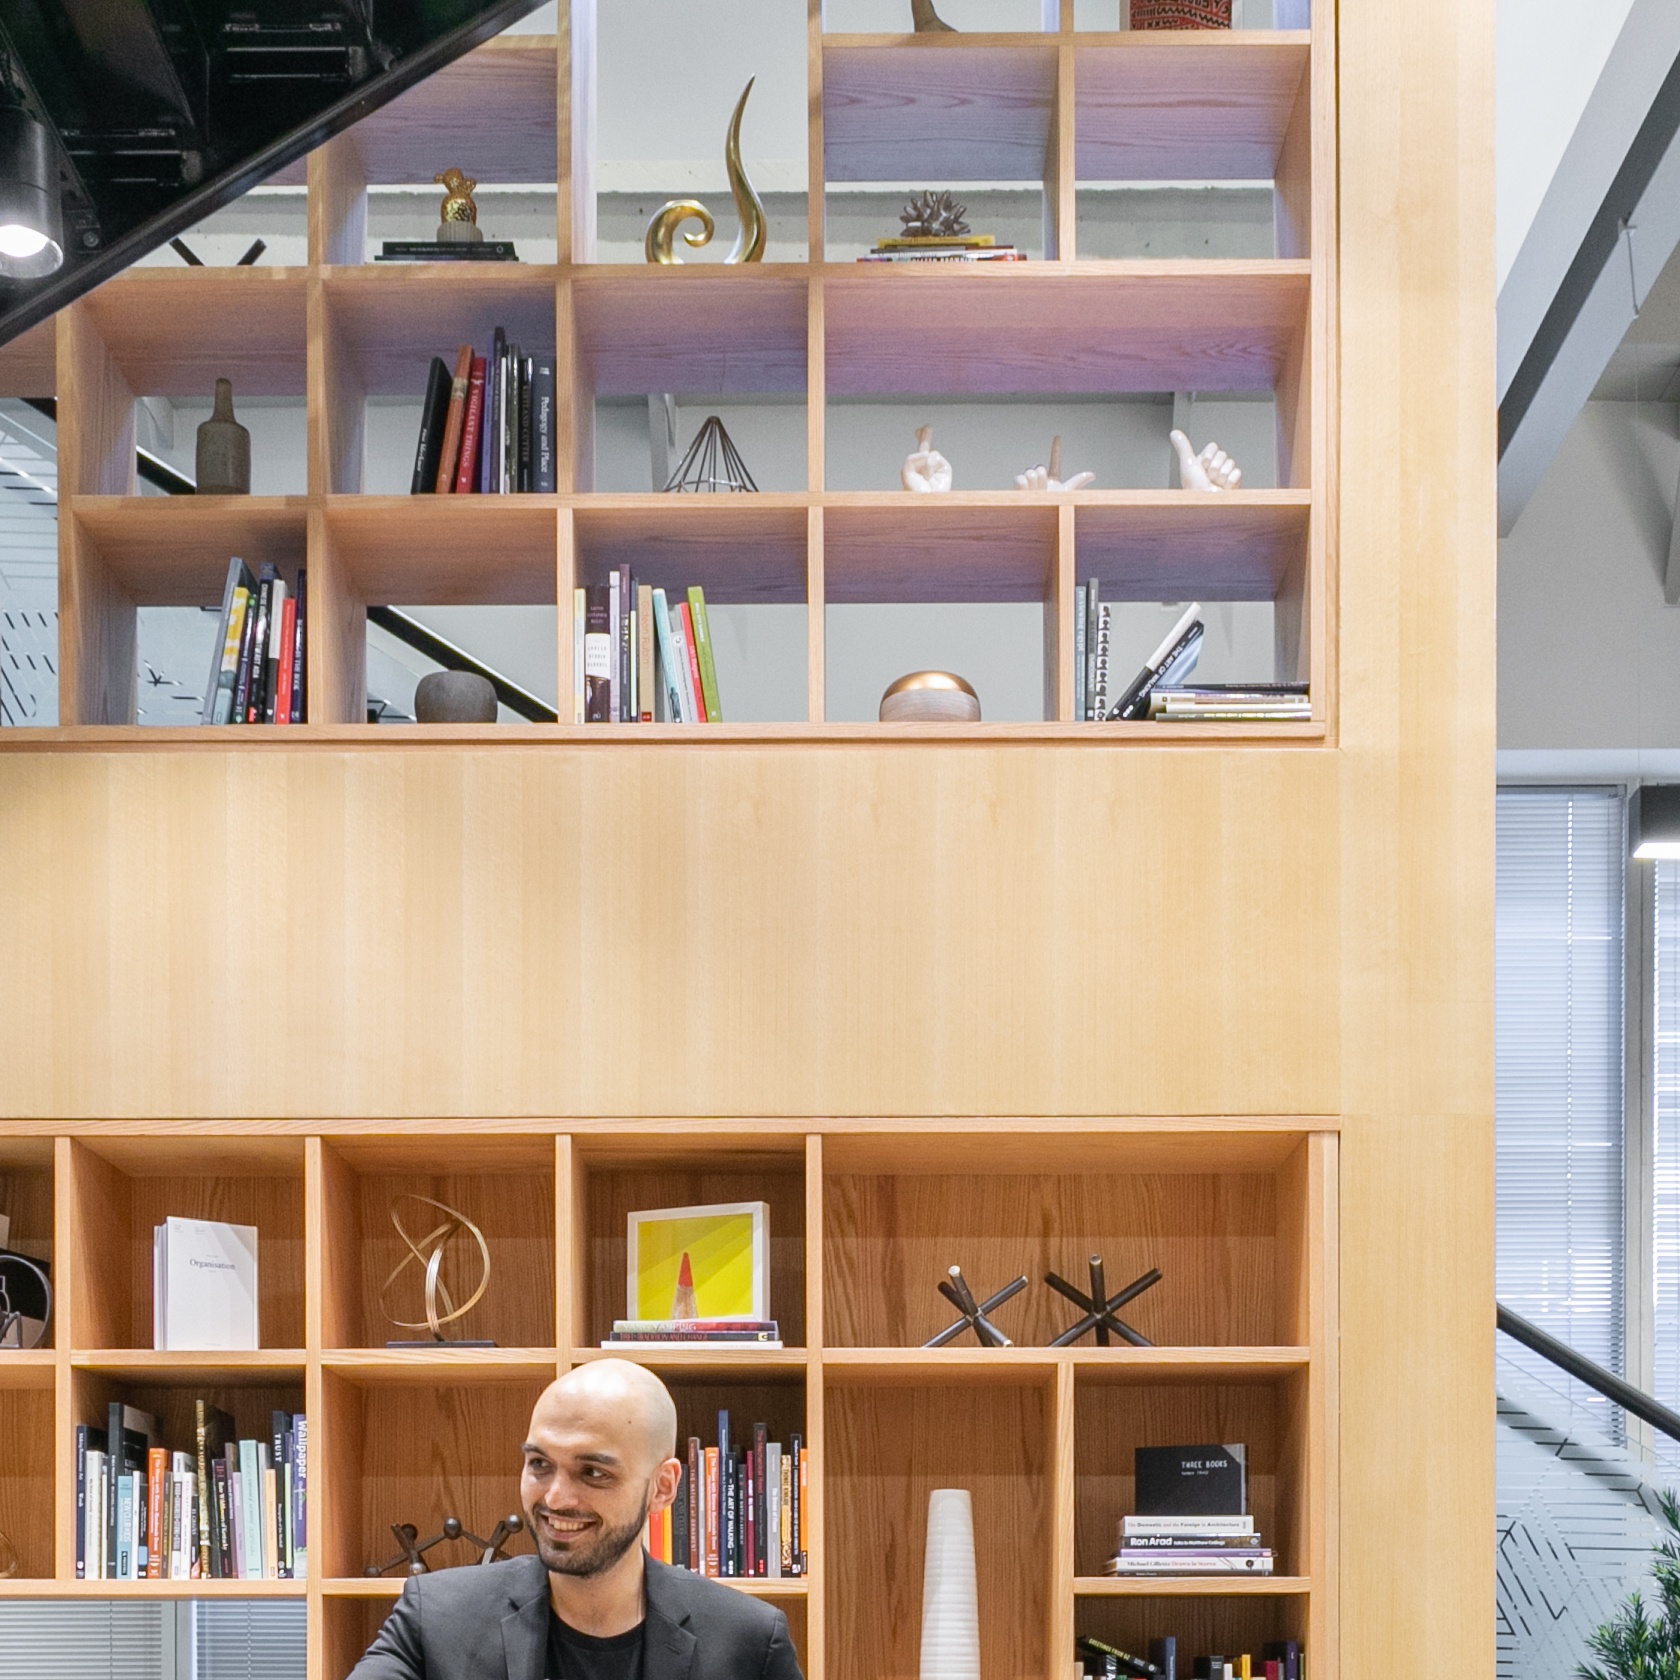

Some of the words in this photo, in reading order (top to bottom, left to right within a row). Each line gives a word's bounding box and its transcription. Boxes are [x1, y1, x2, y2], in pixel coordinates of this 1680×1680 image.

[467, 389, 479, 432] VIGILANT
[539, 396, 550, 433] Pedagogy
[462, 434, 474, 468] THINGS
[539, 434, 550, 451] and
[540, 451, 550, 473] Place
[641, 600, 650, 634] Gideon
[189, 1258, 236, 1271] Organisation
[274, 1433, 282, 1462] TRUST
[296, 1419, 307, 1478] Wallpaper
[1181, 1461, 1203, 1469] THREE
[1205, 1460, 1228, 1468] BOOKS
[123, 1497, 132, 1512] NEW
[727, 1510, 734, 1520] OF
[123, 1528, 132, 1542] KIDS
[220, 1527, 228, 1551] Kentucky
[1130, 1537, 1149, 1546] Ron
[1149, 1537, 1172, 1546] Arad
[1087, 1637, 1112, 1653] GREETINGS
[1110, 1647, 1124, 1658] FROM
